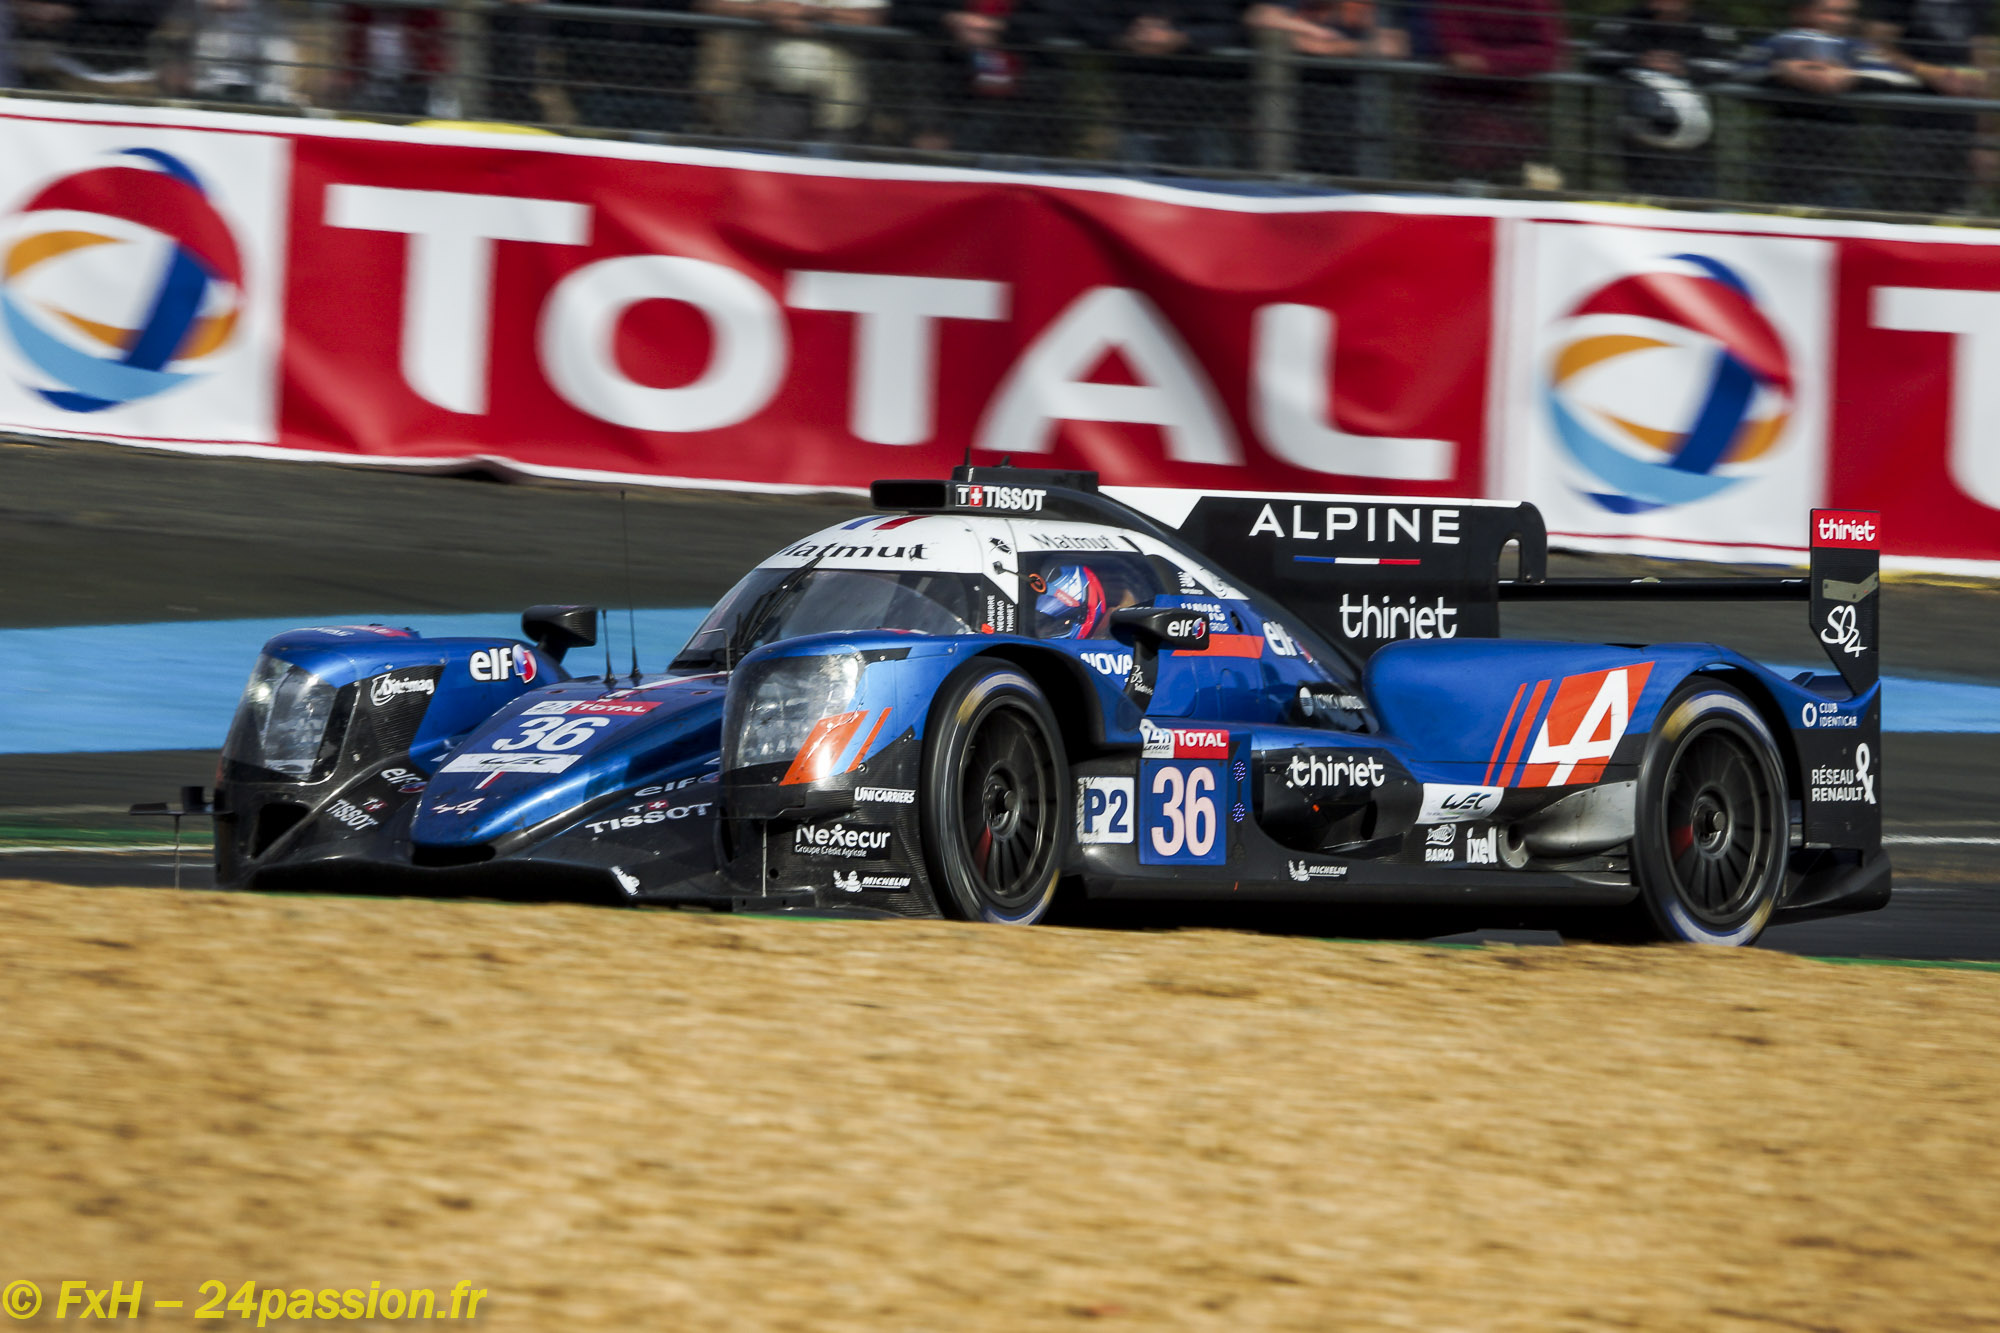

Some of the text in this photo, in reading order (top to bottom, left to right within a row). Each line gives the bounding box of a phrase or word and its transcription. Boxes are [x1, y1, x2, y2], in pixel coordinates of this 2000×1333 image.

[324, 184, 1457, 481] TOTAL
[983, 485, 1046, 511] TISSOT
[1248, 503, 1461, 545] ALPINE
[1818, 518, 1876, 542] thiriet
[1029, 534, 1119, 551] Matmut
[1167, 619, 1194, 637] elf
[1339, 593, 1458, 640] thiriet
[469, 647, 513, 682] elf
[579, 703, 647, 713] TOTAL
[1819, 703, 1838, 714] CLUB
[1819, 716, 1857, 728] IDENTICAR
[492, 716, 610, 752] 36
[1174, 729, 1227, 747] TOTAL
[1290, 755, 1385, 788] thiriet
[1811, 764, 1854, 786] RÉSEAU
[634, 777, 697, 797] elf
[854, 786, 916, 804] UNICARRIERS
[1811, 787, 1863, 802] RENAULT
[1083, 788, 1128, 835] P2
[1151, 766, 1216, 857] 36
[1440, 792, 1492, 810] WEC
[326, 799, 379, 831] TISSOT
[585, 802, 713, 834] TISSOT
[795, 824, 891, 848] Nexecur
[1466, 826, 1498, 864] ixell
[794, 844, 820, 855] Groupe
[841, 847, 867, 858] Agricole
[861, 876, 911, 887] MICHELIN
[1308, 865, 1348, 877] MICHELIN
